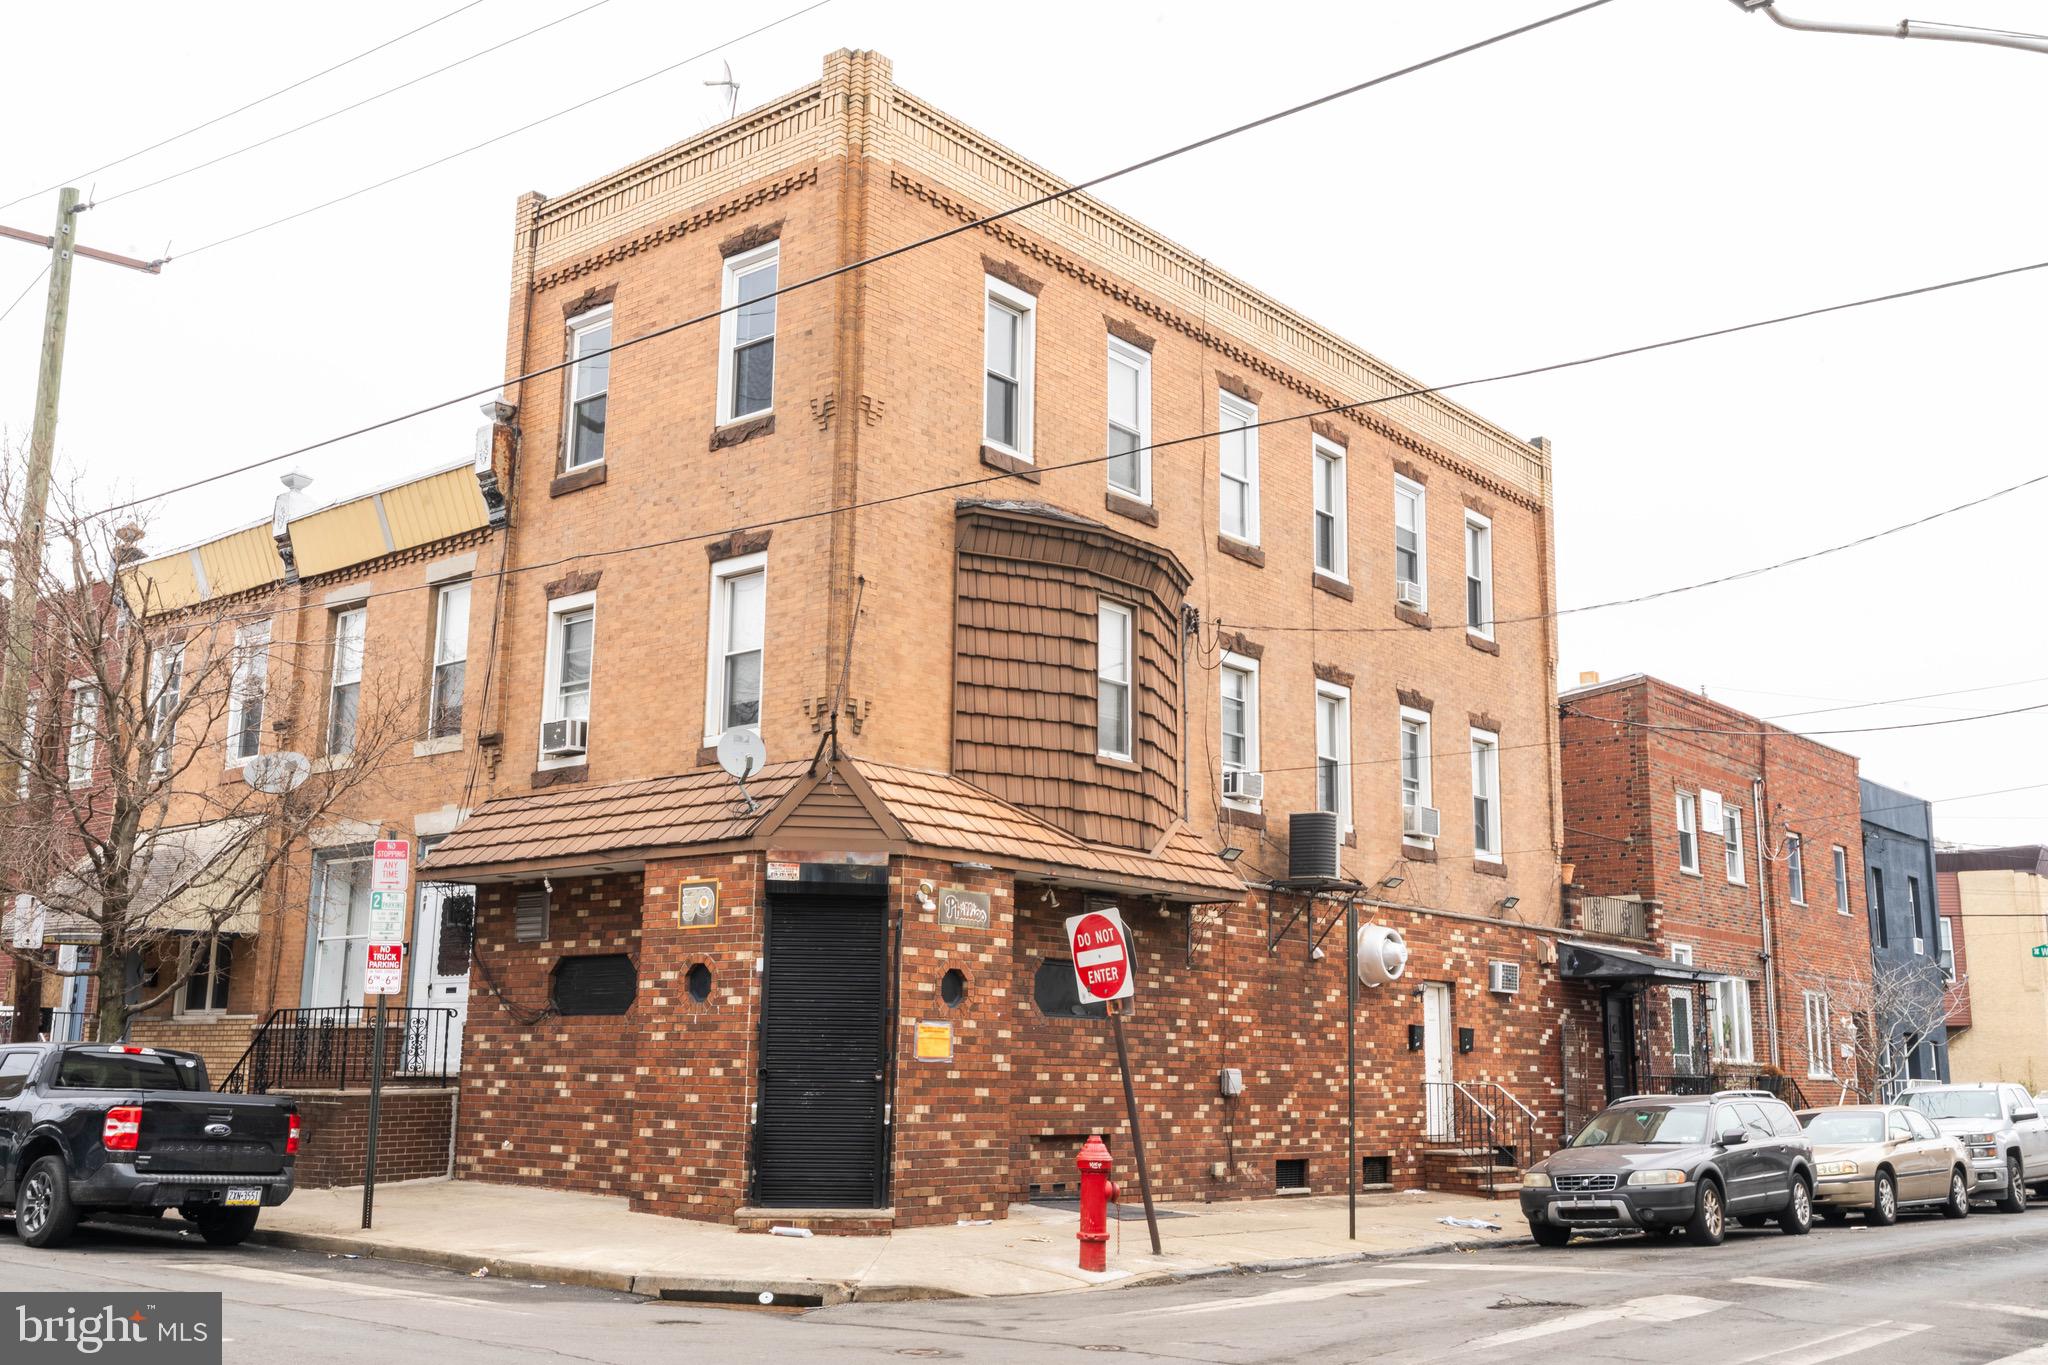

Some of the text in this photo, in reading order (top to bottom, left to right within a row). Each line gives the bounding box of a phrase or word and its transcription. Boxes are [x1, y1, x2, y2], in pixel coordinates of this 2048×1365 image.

[387, 842, 396, 850] NO
[377, 850, 406, 858] STOPPING
[383, 861, 399, 869] ANY
[382, 870, 399, 879] TIME
[373, 894, 381, 908] 2
[945, 895, 987, 923] Phillies
[1077, 927, 1115, 947] DO NOT
[380, 945, 391, 953] NO
[373, 953, 398, 961] TRUCK
[369, 961, 400, 969] PARKING
[1088, 966, 1119, 985] ENTER
[368, 976, 374, 984] 6
[386, 976, 391, 985] 6
